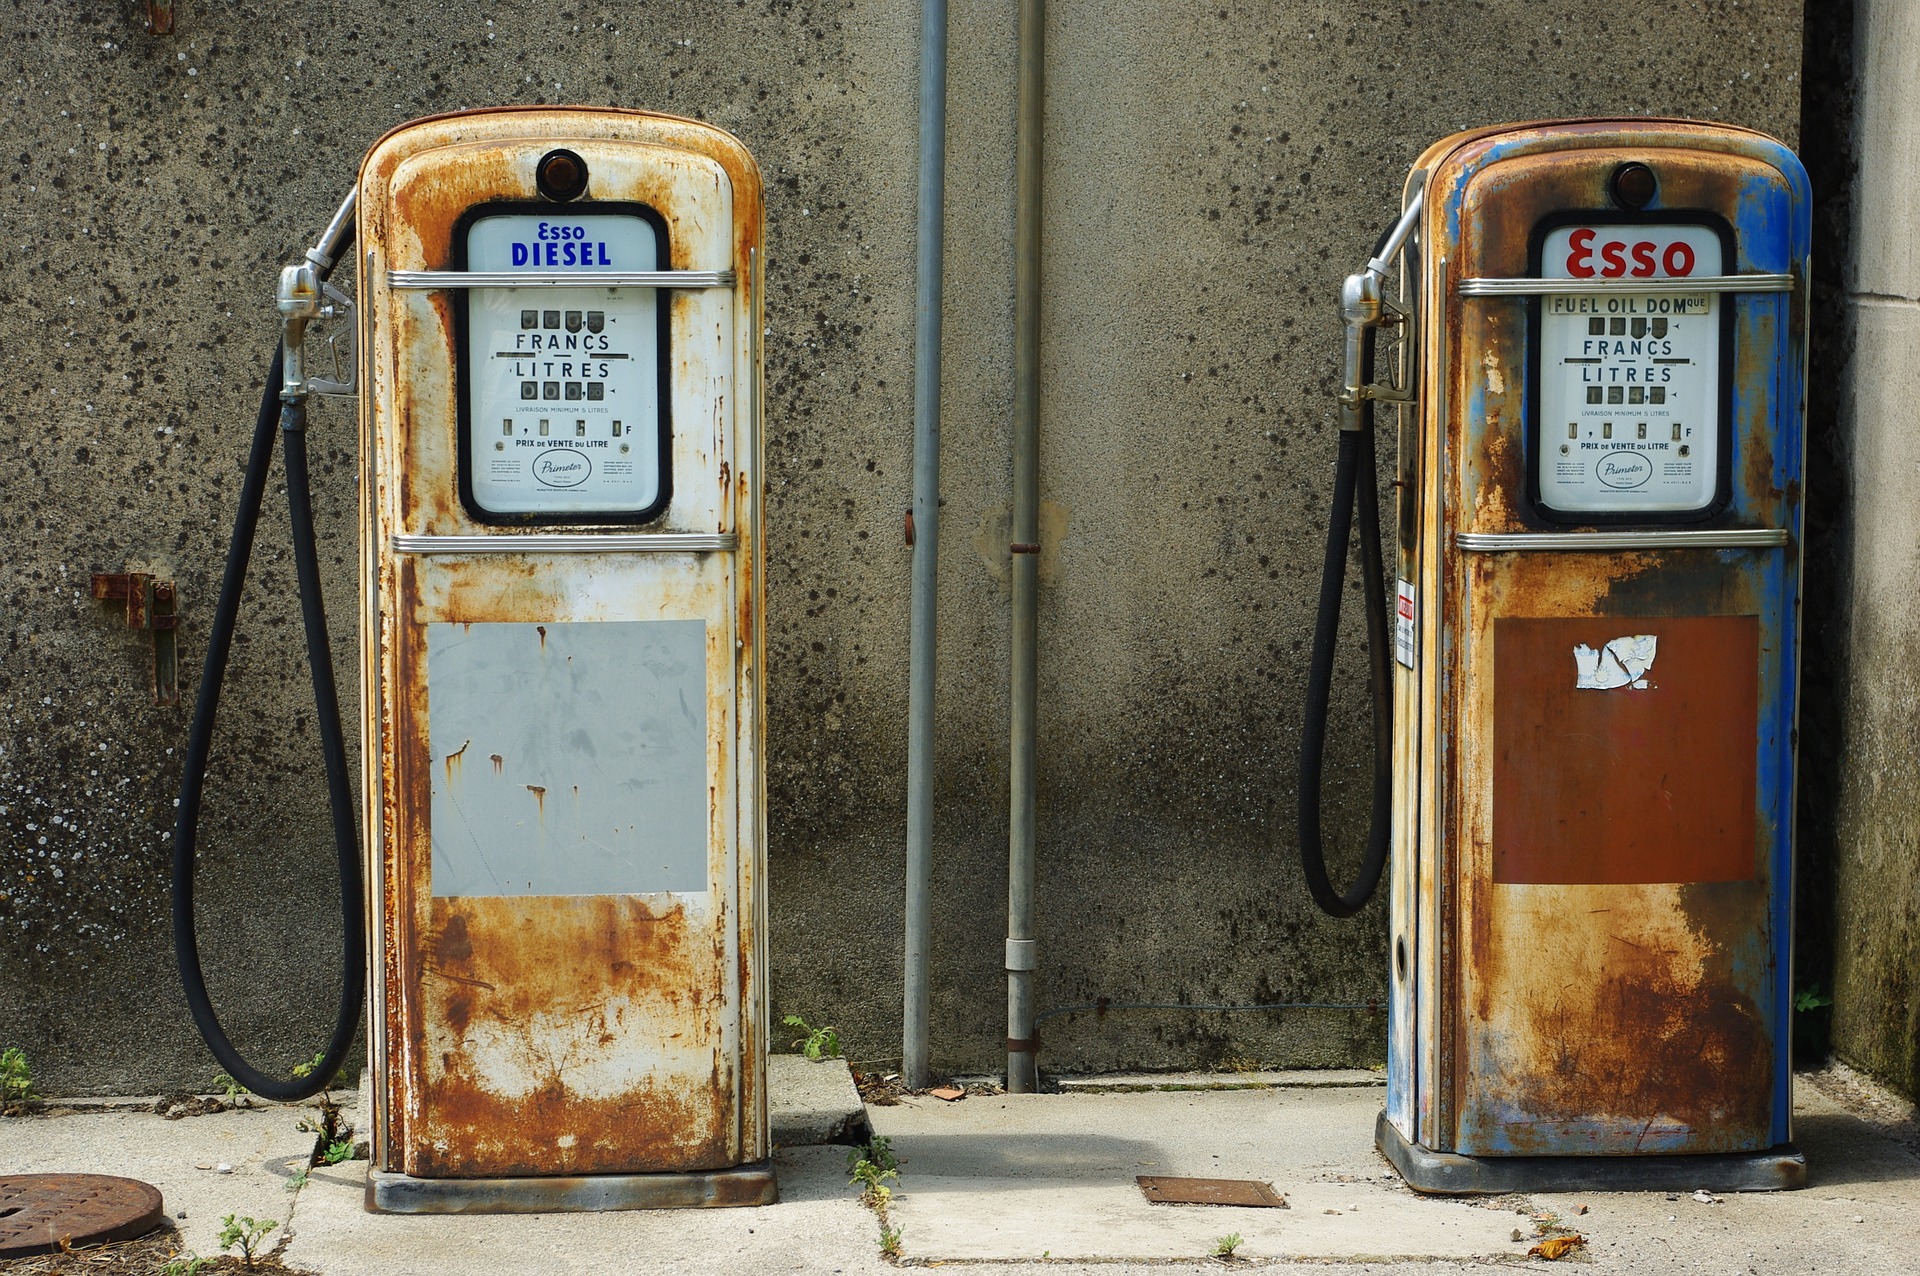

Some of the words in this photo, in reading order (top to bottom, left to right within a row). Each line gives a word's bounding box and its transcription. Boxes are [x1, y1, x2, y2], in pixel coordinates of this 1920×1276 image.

[511, 242, 612, 267] DIESEL
[1554, 298, 1599, 314] FUEL
[1607, 298, 1637, 314] OIL
[516, 334, 609, 350] FRANCS
[1583, 340, 1672, 355] FRANCS
[516, 362, 609, 378] LITRES
[1582, 367, 1671, 382] LITRES
[626, 425, 632, 435] F
[1685, 428, 1692, 437] F
[547, 440, 573, 448] VENTE
[586, 440, 609, 448] LITRE
[1581, 442, 1599, 450] PRIX
[1611, 442, 1636, 450] VENTE
